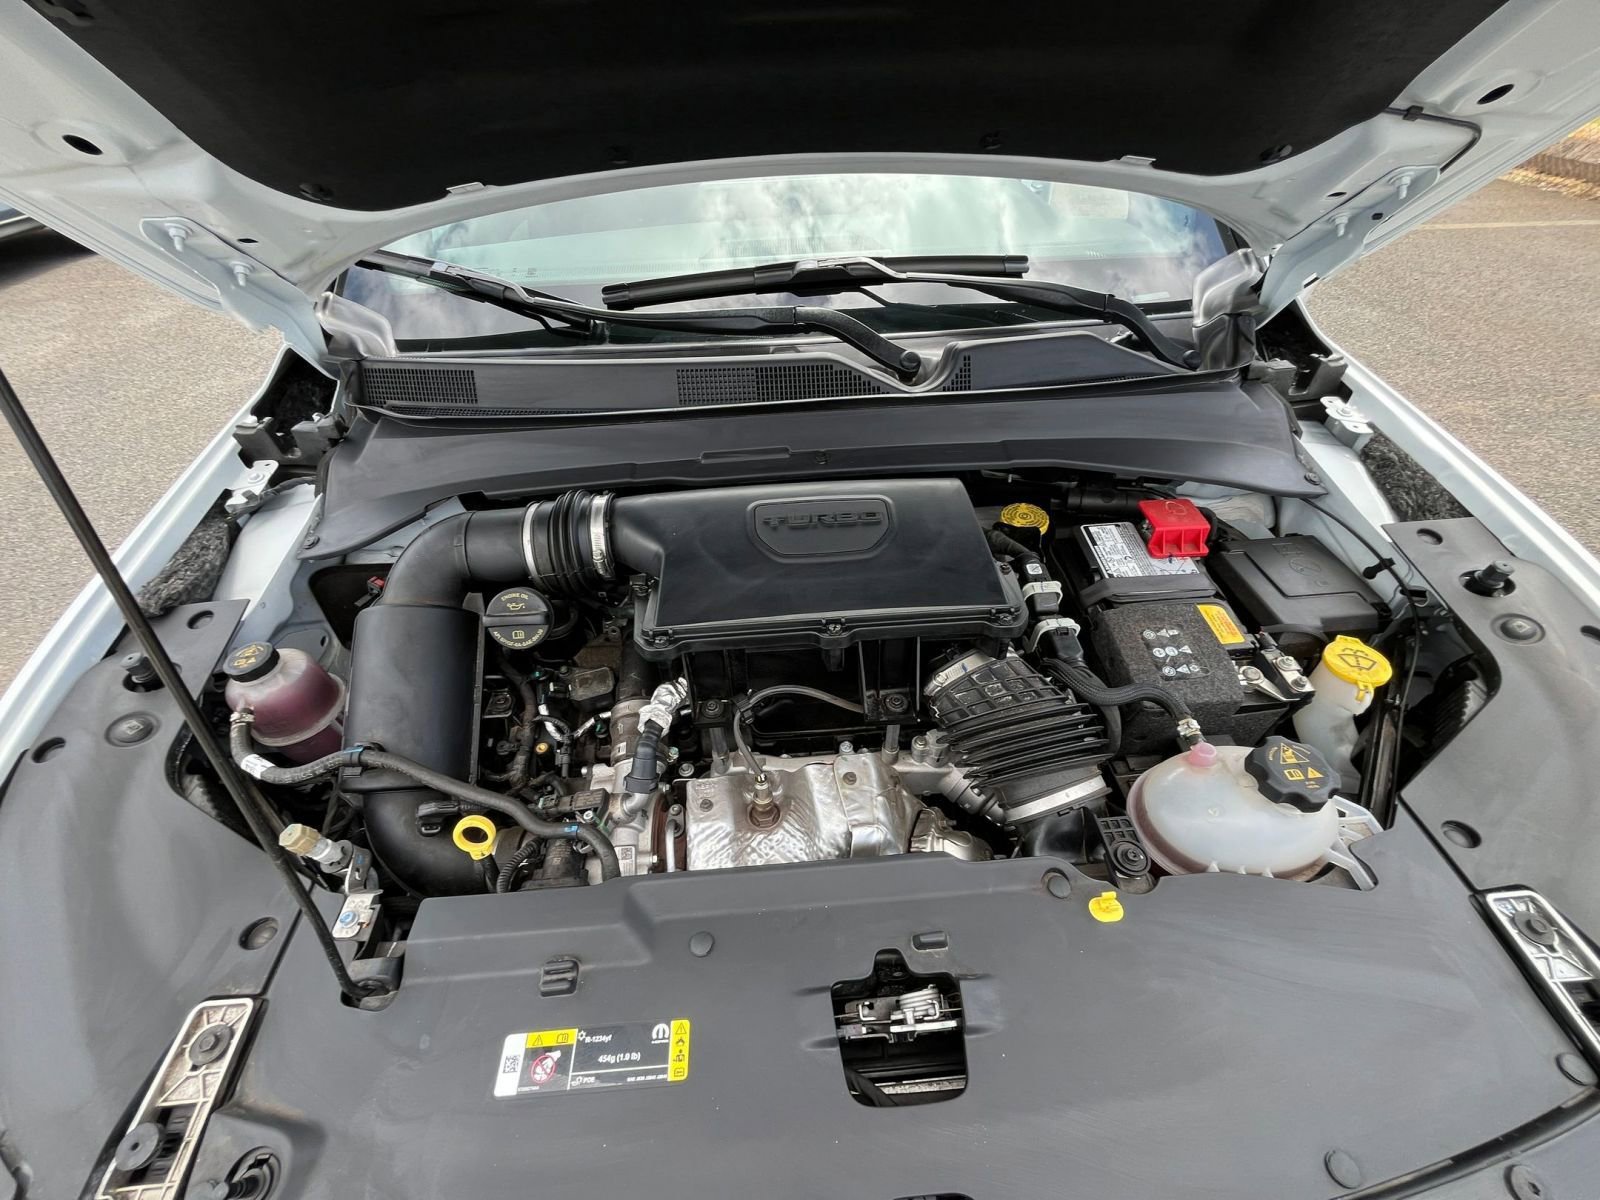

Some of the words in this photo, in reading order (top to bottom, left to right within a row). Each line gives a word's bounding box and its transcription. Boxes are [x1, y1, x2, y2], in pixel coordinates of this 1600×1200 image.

[762, 511, 882, 531] TURBO
[501, 593, 520, 601] ENGINE
[598, 1054, 616, 1064] 454g
[616, 1053, 630, 1063] (1.0
[630, 1052, 641, 1062] lb)
